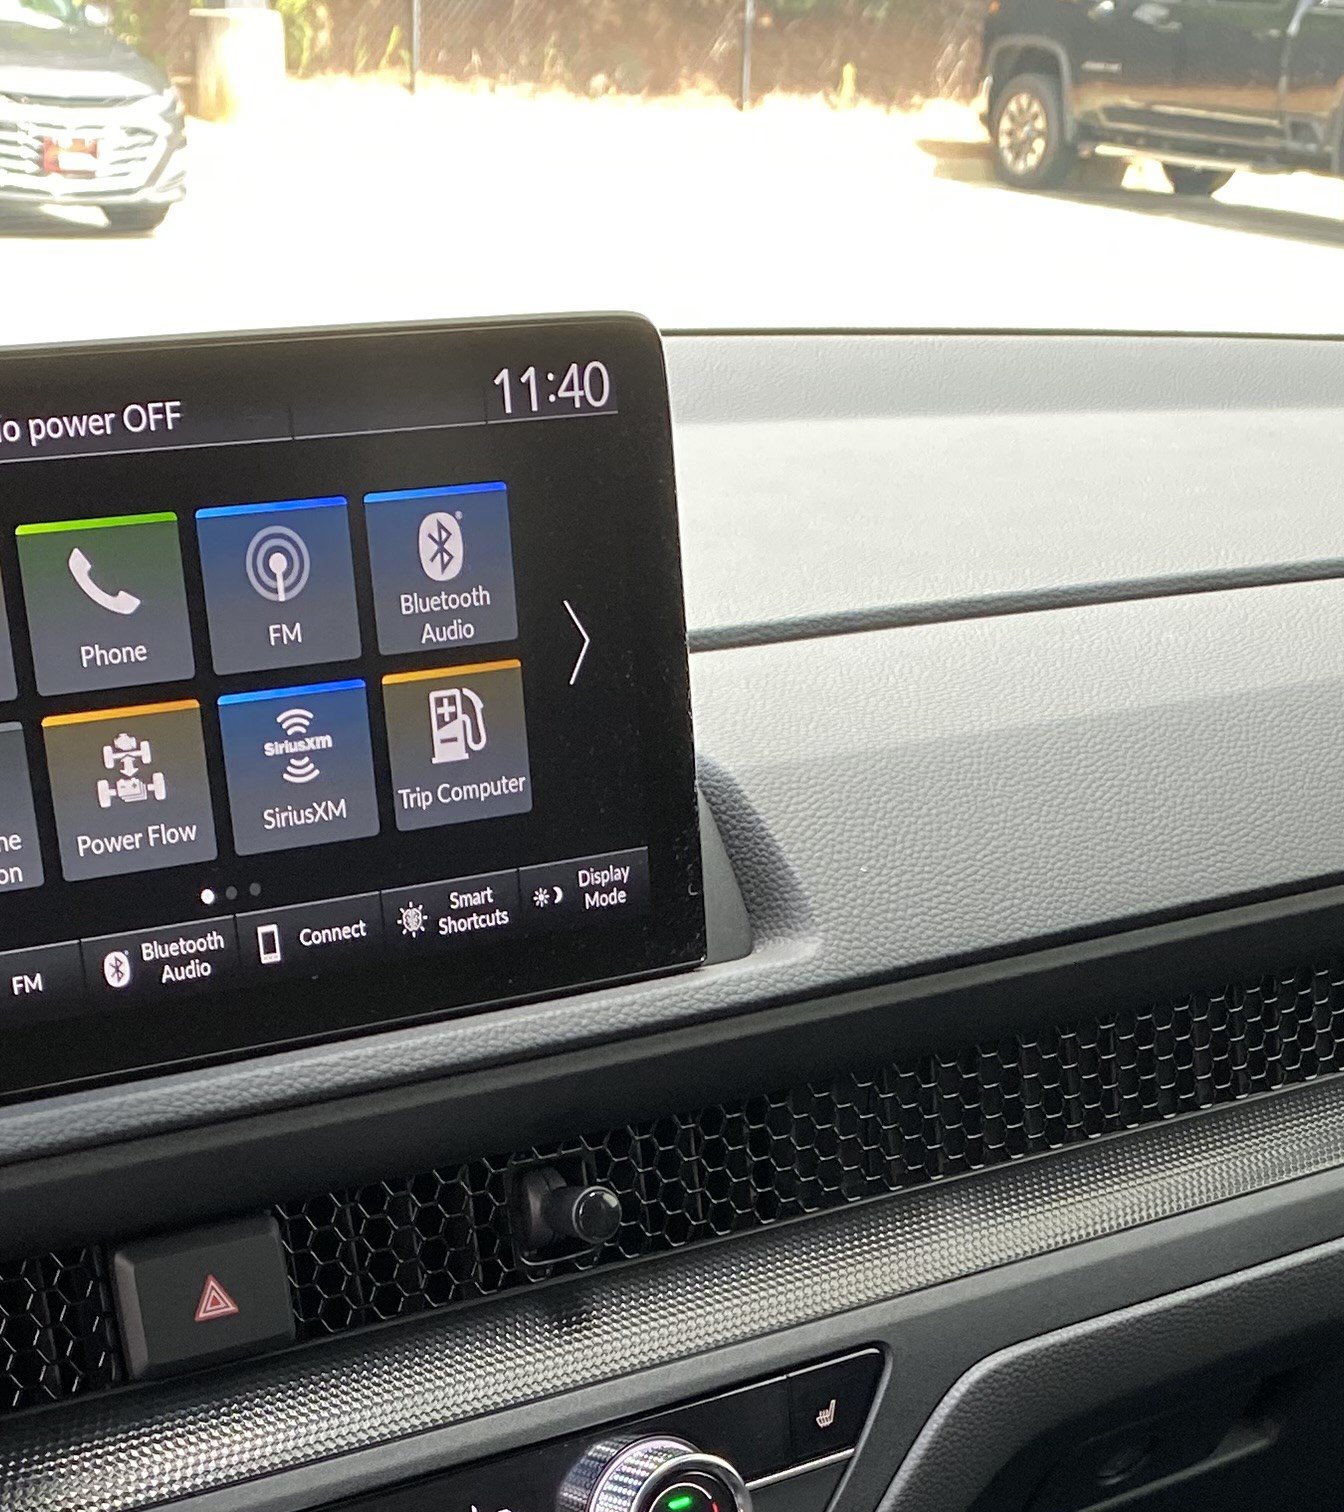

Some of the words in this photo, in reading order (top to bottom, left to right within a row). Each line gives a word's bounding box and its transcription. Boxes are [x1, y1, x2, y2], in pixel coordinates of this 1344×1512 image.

[494, 360, 611, 414] 11:40
[28, 412, 116, 446] power
[123, 400, 182, 433] OFF
[400, 586, 491, 616] Bluetooth
[268, 622, 303, 646] FM
[421, 619, 475, 645] Audio
[80, 642, 148, 668] Phone
[398, 786, 433, 811] Trip
[436, 773, 526, 805] Computer
[262, 798, 348, 831] SiriusXM
[76, 833, 142, 858] Power
[147, 823, 197, 849] Flow
[577, 864, 630, 891] Display
[449, 886, 494, 910] Smart
[583, 885, 627, 909] Mode
[299, 918, 367, 947] Connect
[438, 906, 509, 936] Shortcuts
[141, 930, 225, 962] Bluetooth
[11, 972, 43, 996] FM
[161, 957, 212, 985] Audio
